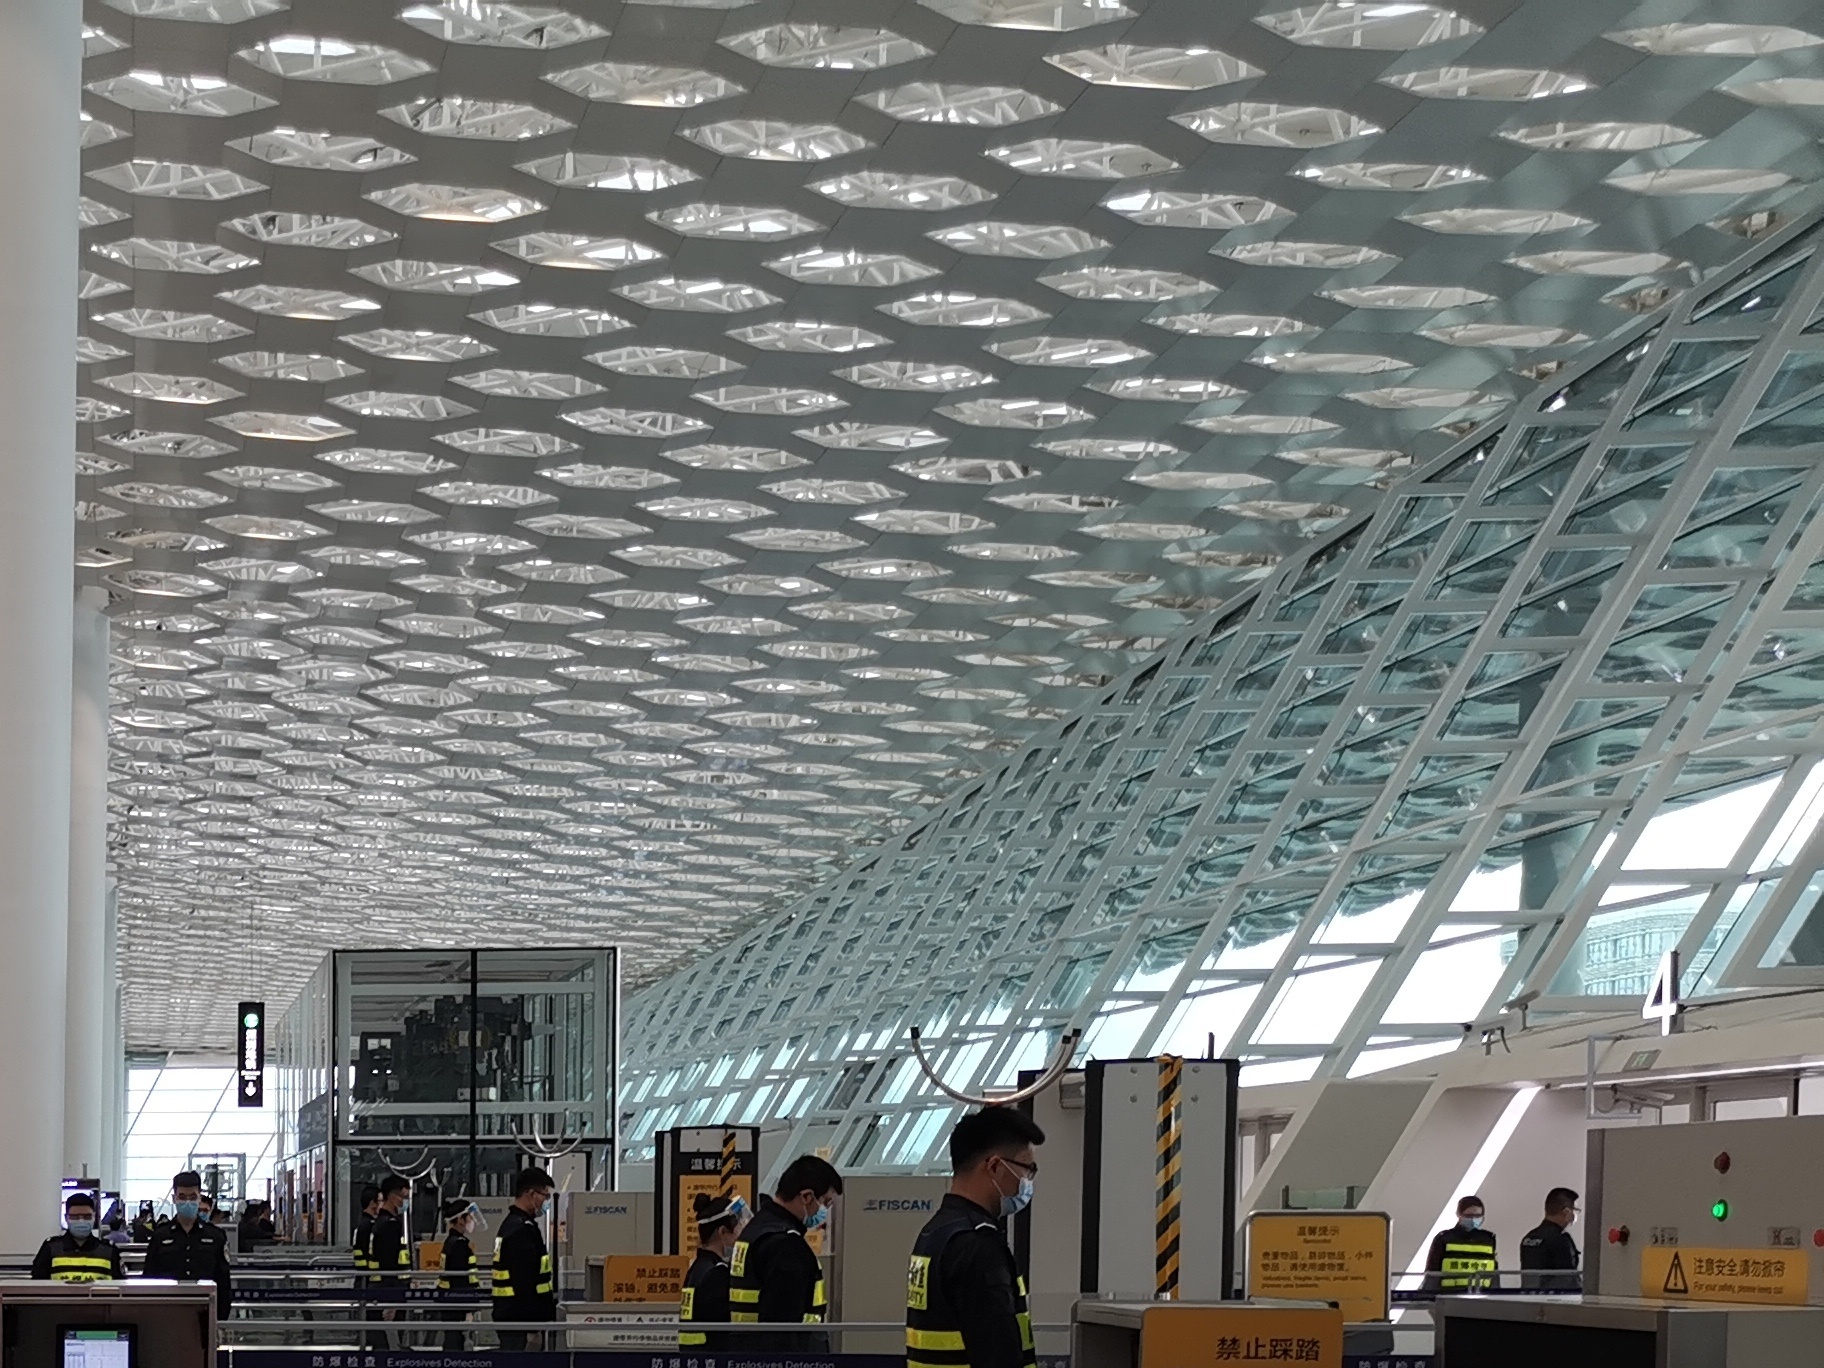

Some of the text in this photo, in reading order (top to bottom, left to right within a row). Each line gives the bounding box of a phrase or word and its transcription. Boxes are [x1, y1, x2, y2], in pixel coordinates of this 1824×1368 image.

[1643, 949, 1677, 1036] 4
[878, 1199, 931, 1211] FISCAN
[1214, 1336, 1321, 1361] 禁止踩踏
[312, 1355, 376, 1368] 防爆检查
[386, 1357, 493, 1368] Explosives Detection
